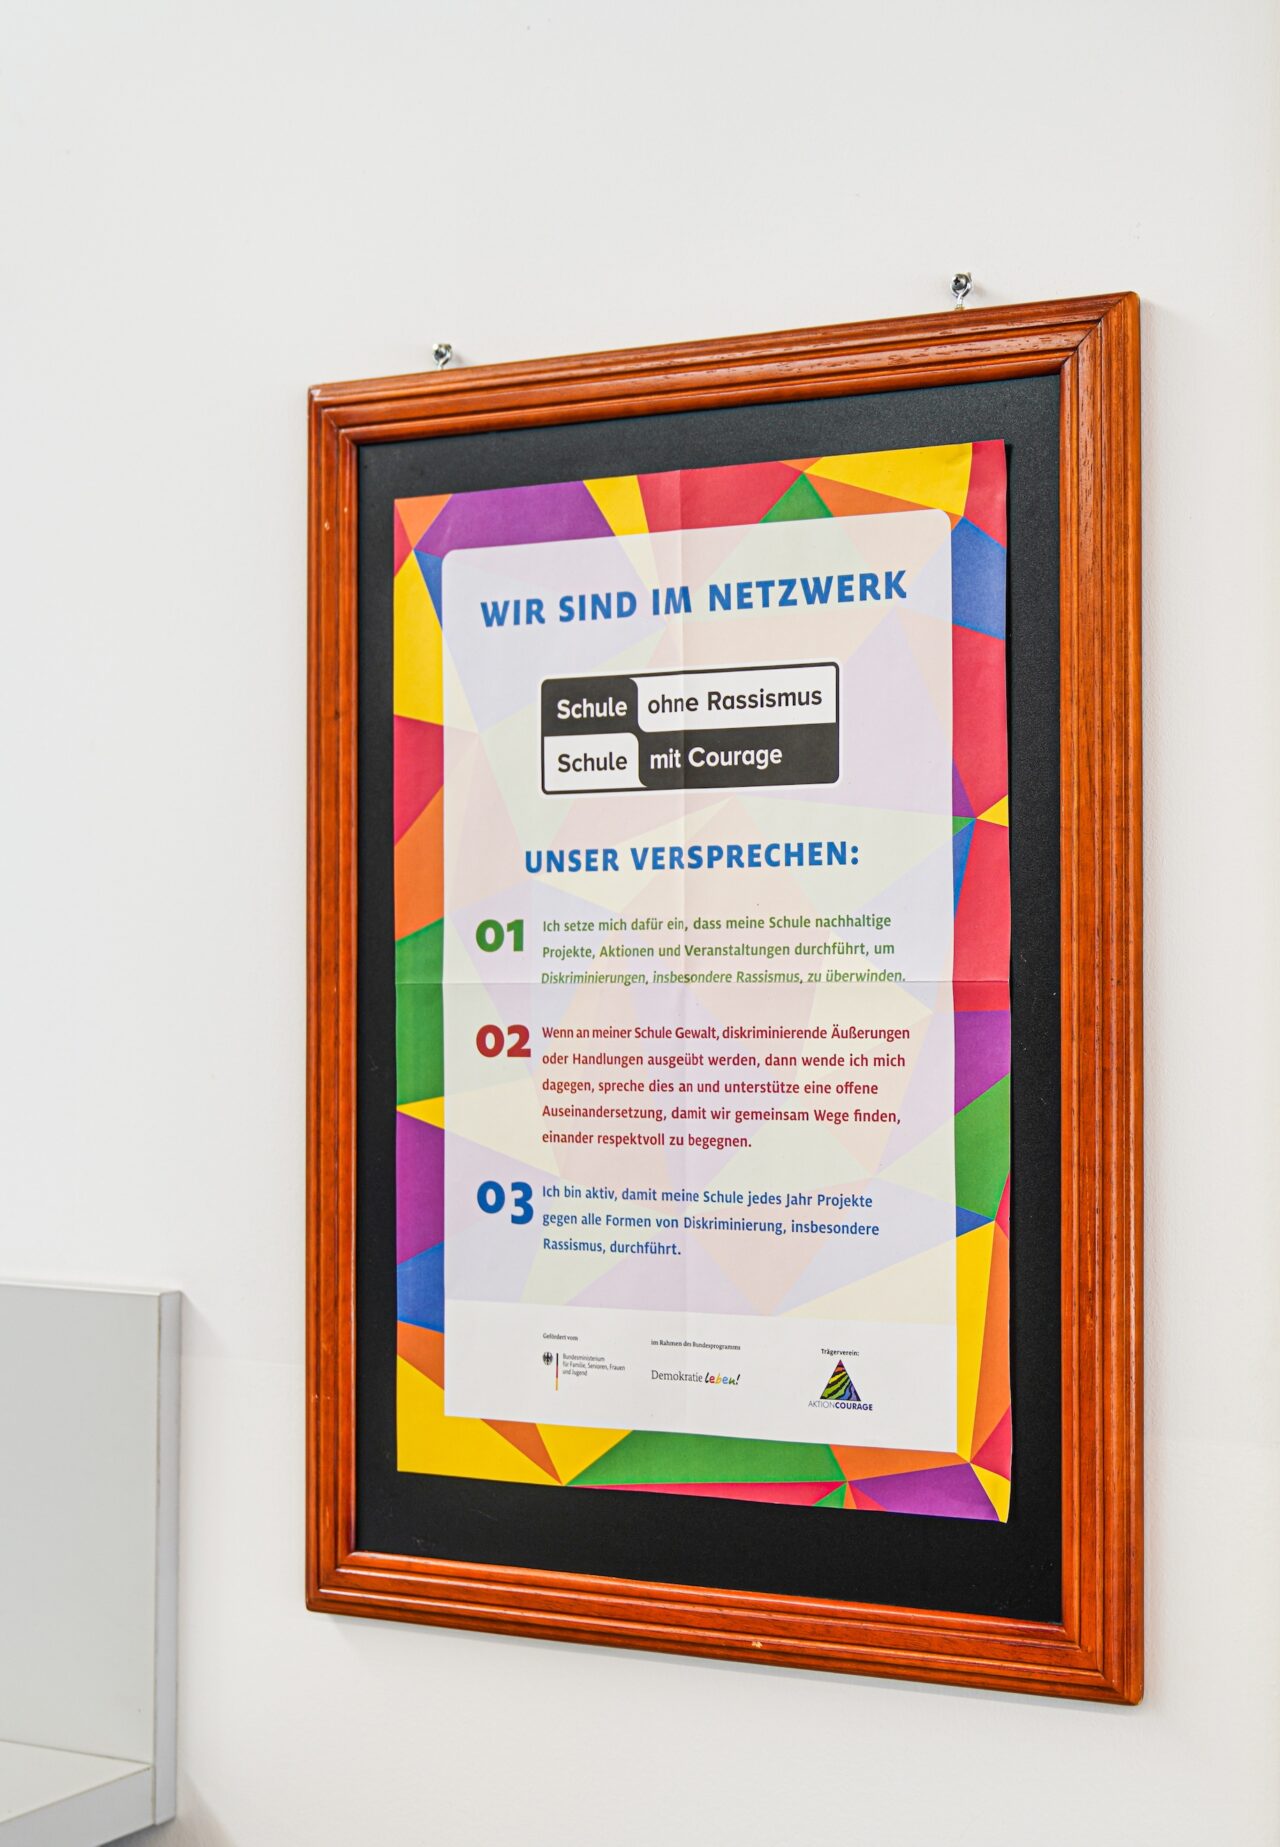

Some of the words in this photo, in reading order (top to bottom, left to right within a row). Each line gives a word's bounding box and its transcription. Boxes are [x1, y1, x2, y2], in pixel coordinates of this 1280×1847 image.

[480, 598, 545, 627] WIR
[559, 591, 636, 622] SIND
[652, 585, 691, 615] IM
[709, 570, 906, 611] NETZWERK
[557, 696, 627, 719] Schule
[647, 693, 698, 714] ohne
[707, 688, 822, 710] Rassismus
[557, 751, 627, 772] Schule
[650, 747, 681, 769] mit
[688, 746, 782, 769] Courage
[525, 848, 618, 873] UNSER
[630, 841, 858, 870] VERSPRECHEN:
[542, 919, 560, 932] Ich
[563, 920, 594, 931] setze
[598, 918, 626, 931] mich
[630, 917, 663, 930] dafür
[666, 916, 688, 932] ein,
[692, 916, 721, 929] dass
[725, 915, 764, 928] meine
[768, 915, 810, 928] Schule
[814, 913, 891, 930] nachhaltige
[475, 919, 523, 952] 01
[542, 945, 595, 960] Projekte,
[598, 944, 654, 957] Aktionen
[657, 944, 680, 957] und
[683, 943, 790, 959] Veranstaltungen
[794, 941, 868, 956] durchführt,
[873, 944, 894, 954] um
[541, 970, 648, 987] Diskriminierungen,
[652, 970, 732, 984] insbesondere
[735, 969, 803, 984] Rassismus,
[806, 972, 821, 983] zu
[825, 968, 905, 982] überwinden.
[475, 1024, 531, 1057] 02
[541, 1026, 573, 1038] Wenn
[575, 1028, 589, 1038] an
[591, 1025, 632, 1038] meiner
[634, 1026, 672, 1038] Schule
[674, 1026, 719, 1040] Gewalt,
[721, 1025, 827, 1039] diskriminierende
[830, 1023, 909, 1042] Äußerungen
[541, 1052, 568, 1064] oder
[572, 1052, 643, 1068] Handlungen
[647, 1052, 703, 1068] ausgeübt
[707, 1053, 760, 1067] werden,
[764, 1053, 796, 1066] dann
[801, 1053, 844, 1066] wende
[849, 1053, 868, 1066] ich
[873, 1053, 905, 1066] mich
[541, 1078, 594, 1094] dagegen,
[598, 1079, 644, 1094] spreche
[648, 1079, 674, 1092] dies
[678, 1082, 693, 1092] an
[696, 1080, 719, 1092] und
[724, 1080, 799, 1093] unterstütze
[803, 1080, 831, 1094] eine
[835, 1080, 878, 1094] offene
[541, 1104, 666, 1122] Auseinandersetzung,
[670, 1106, 706, 1119] damit
[710, 1106, 730, 1119] wir
[734, 1107, 809, 1123] gemeinsam
[813, 1109, 849, 1125] Wege
[853, 1108, 900, 1124] finden,
[541, 1130, 593, 1143] einander
[597, 1132, 664, 1147] respektvoll
[669, 1135, 684, 1145] zu
[687, 1133, 751, 1150] begegnen.
[476, 1180, 533, 1224] 03
[542, 1185, 559, 1197] Ich
[563, 1185, 581, 1197] bin
[585, 1186, 617, 1201] aktiv,
[621, 1187, 657, 1201] damit
[661, 1188, 699, 1202] meine
[703, 1190, 743, 1203] Schule
[746, 1190, 781, 1207] jedes
[784, 1192, 812, 1208] Jahr
[817, 1193, 872, 1209] Projekte
[542, 1213, 577, 1227] gegen
[580, 1212, 601, 1225] alle
[605, 1214, 651, 1227] Formen
[655, 1218, 678, 1228] von
[683, 1215, 786, 1235] Diskriminierung,
[791, 1219, 879, 1235] insbesondere
[543, 1237, 605, 1254] Rassismus,
[609, 1240, 681, 1255] durchführt.
[821, 1348, 860, 1356] Trägerverein:
[651, 1370, 702, 1382] Demokratie
[704, 1372, 740, 1386] leben!
